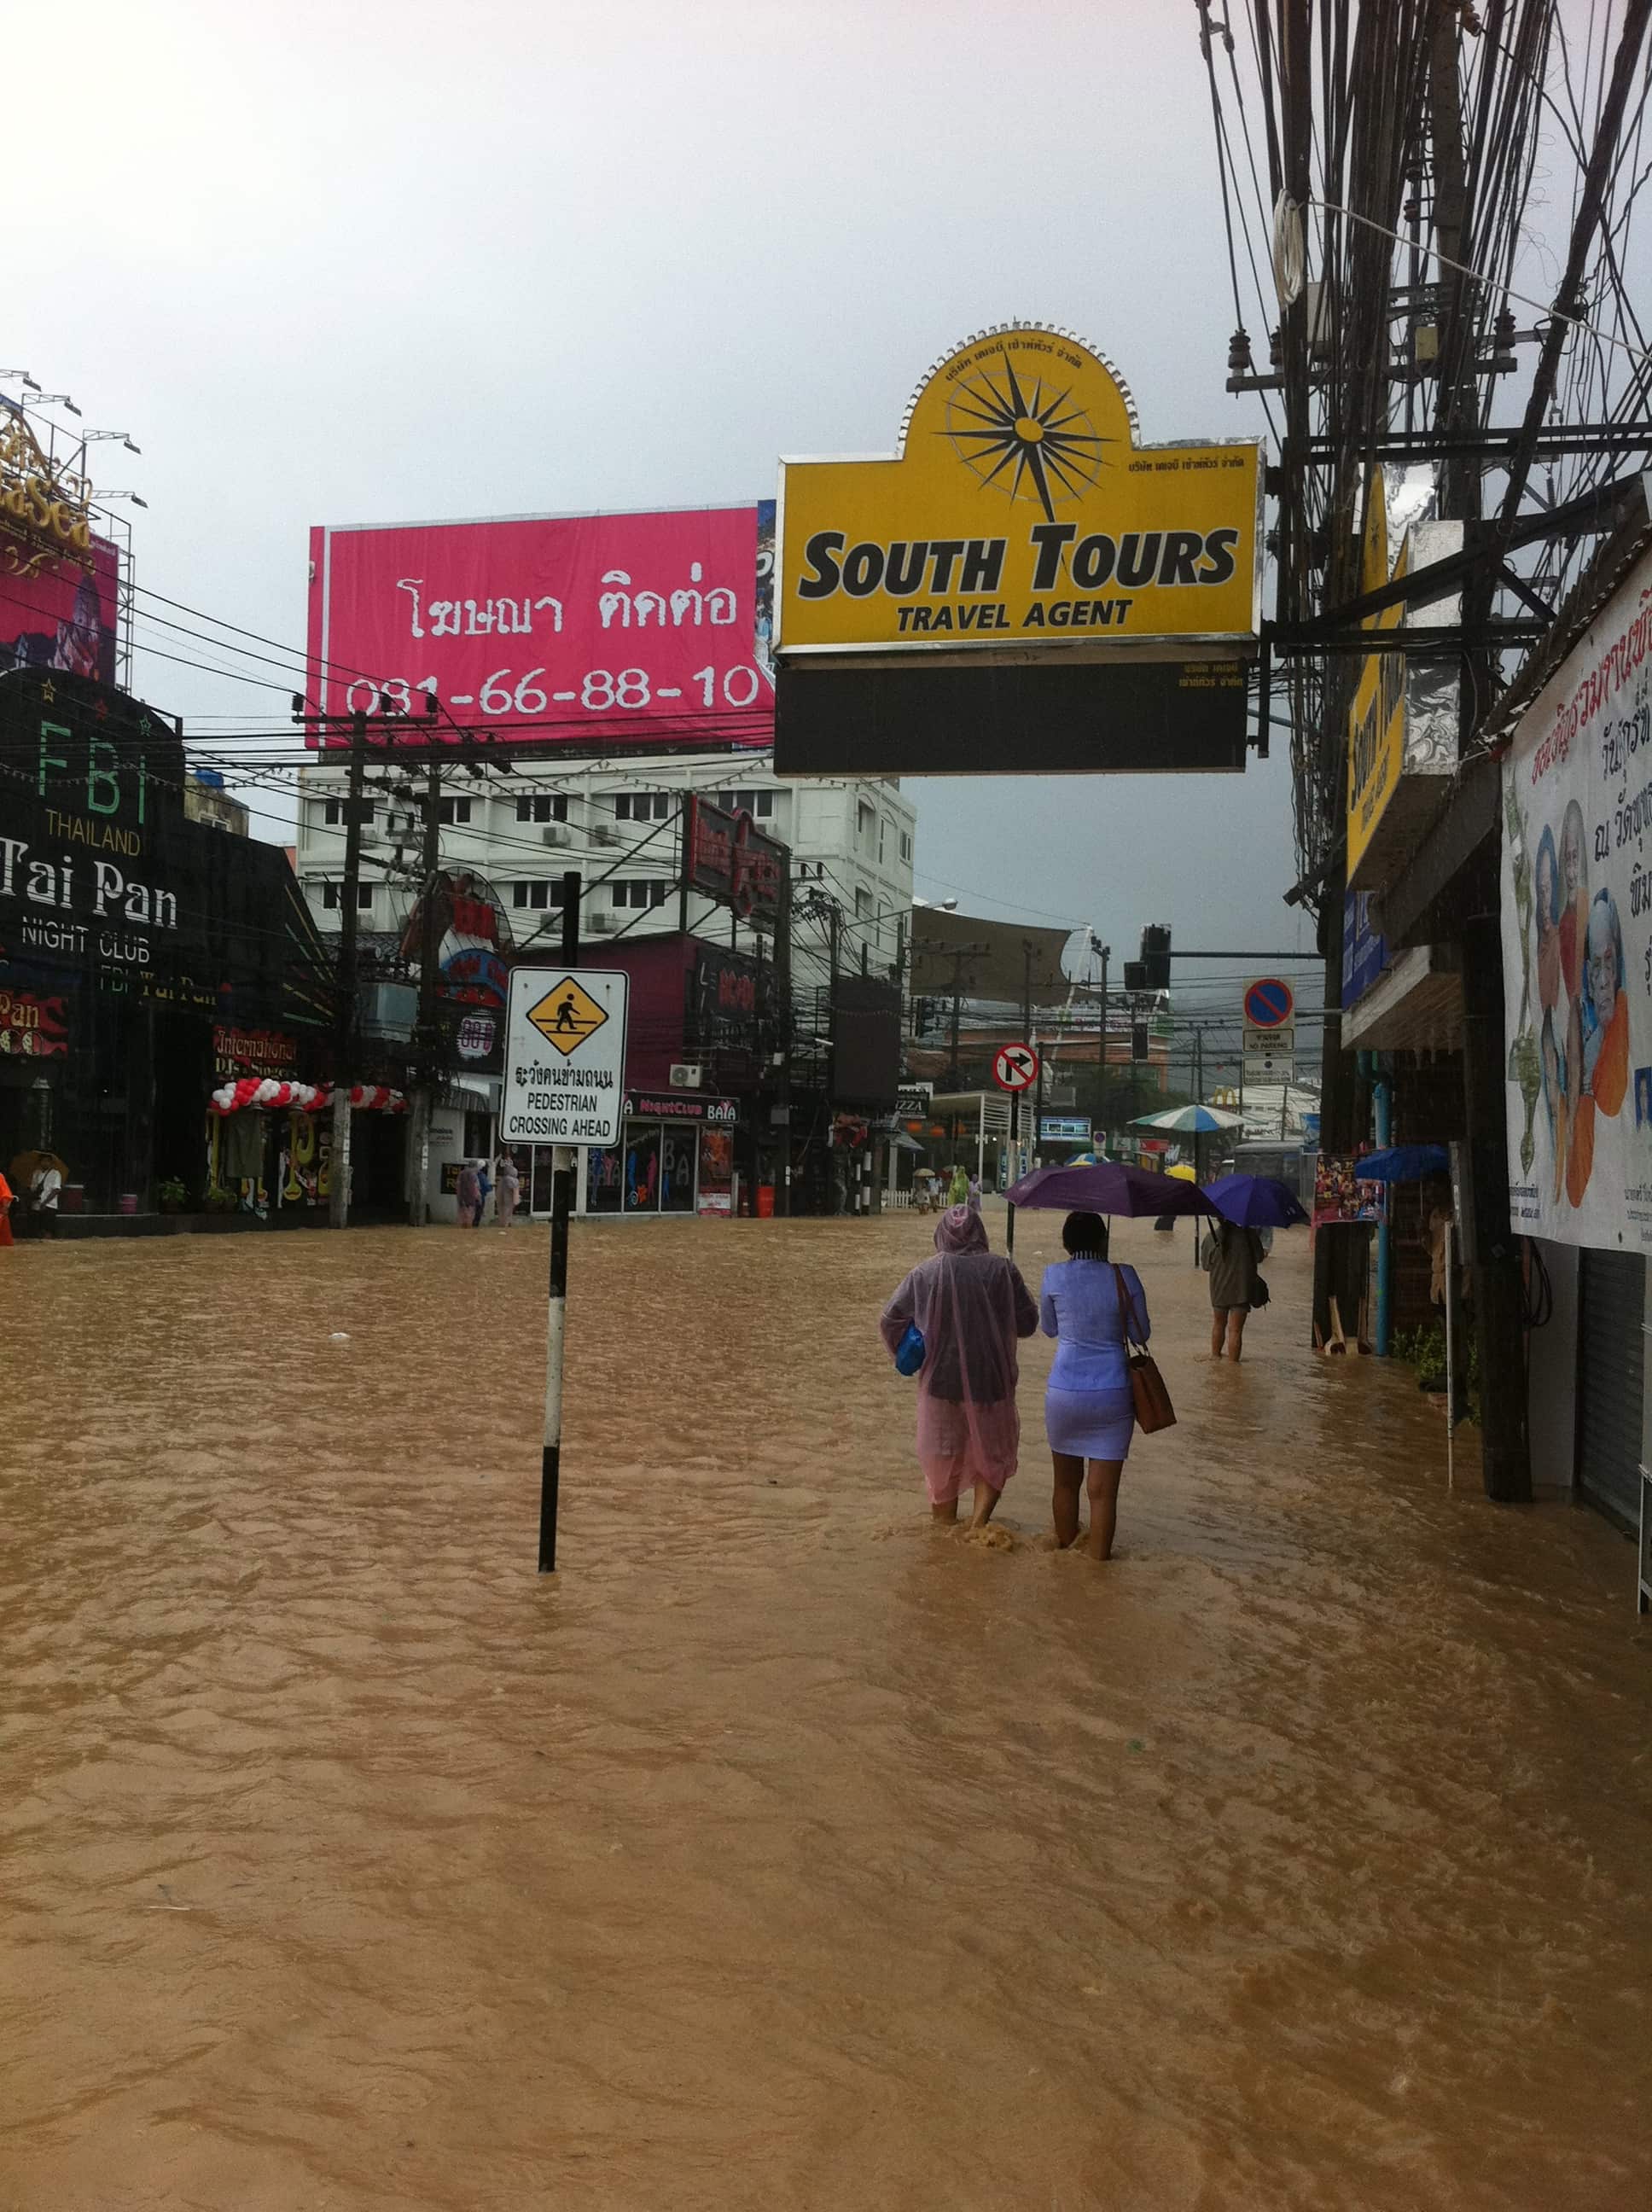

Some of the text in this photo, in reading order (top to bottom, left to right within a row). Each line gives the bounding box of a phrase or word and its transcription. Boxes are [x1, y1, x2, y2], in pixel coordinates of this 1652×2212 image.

[798, 522, 1239, 600] SOUTH TOURS
[396, 579, 563, 638] โฆษณา
[598, 562, 737, 628] ติดต่อ
[897, 598, 1134, 632] TRAVEL AGENT
[38, 719, 146, 824] FBI
[45, 809, 141, 857] THAILAND
[0, 836, 177, 929] Tai Pan
[22, 916, 150, 963] NIGHT CLUB
[527, 1092, 597, 1112] PEDESTRIAN
[894, 1100, 922, 1111] IZZA
[509, 1116, 611, 1137] CROSSING AHEAD
